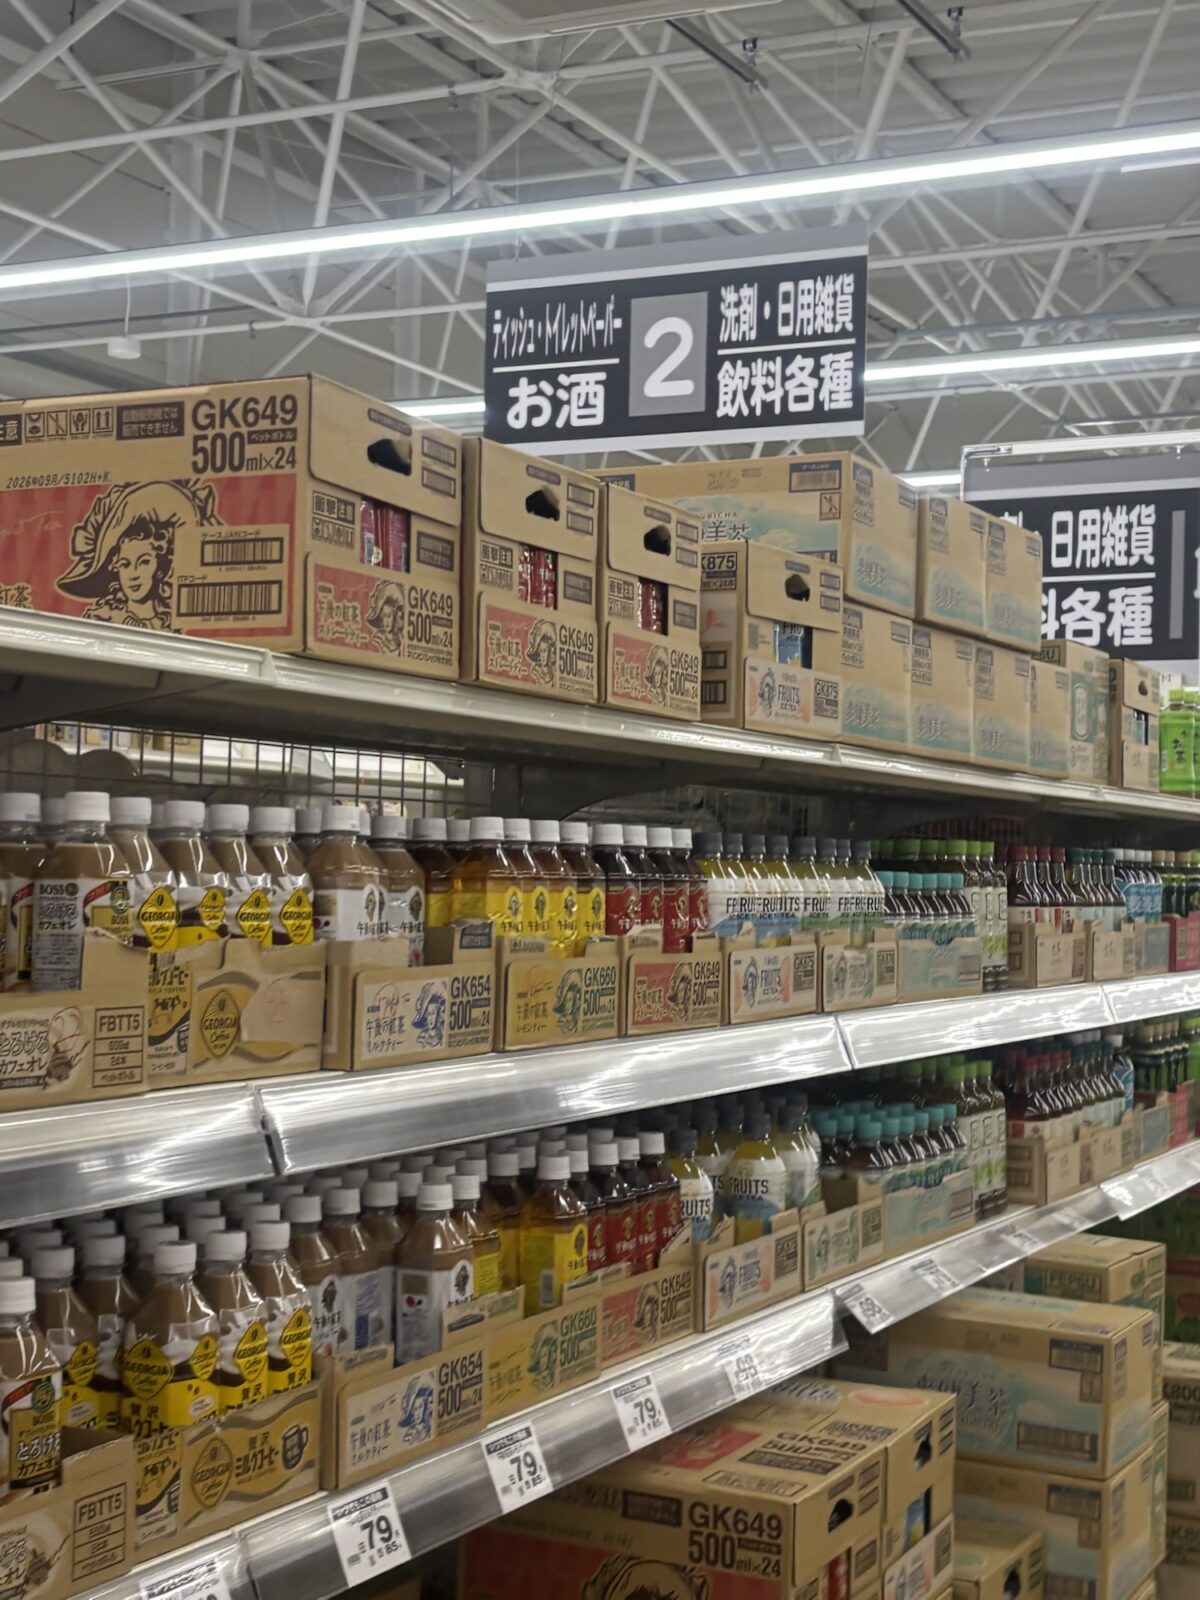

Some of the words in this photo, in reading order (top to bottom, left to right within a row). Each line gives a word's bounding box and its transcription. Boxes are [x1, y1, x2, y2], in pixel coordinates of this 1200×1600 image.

[719, 273, 854, 342] 洗剤・日用雑貨
[643, 315, 699, 398] 2
[506, 371, 607, 429] お酒
[717, 352, 854, 417] 飲料各種
[192, 394, 298, 431] GK649
[407, 585, 453, 616] GK649
[559, 623, 595, 653] GK649
[584, 966, 617, 988] GK660
[693, 960, 720, 981] GK649
[450, 975, 491, 999] GK654
[98, 1014, 140, 1032] FBTT5
[438, 1349, 484, 1387] GK654
[632, 1397, 656, 1425] 79
[508, 1451, 537, 1482] 79
[78, 1493, 124, 1523] FBTT5
[688, 1501, 782, 1541] GK649
[360, 1514, 393, 1550] 79
